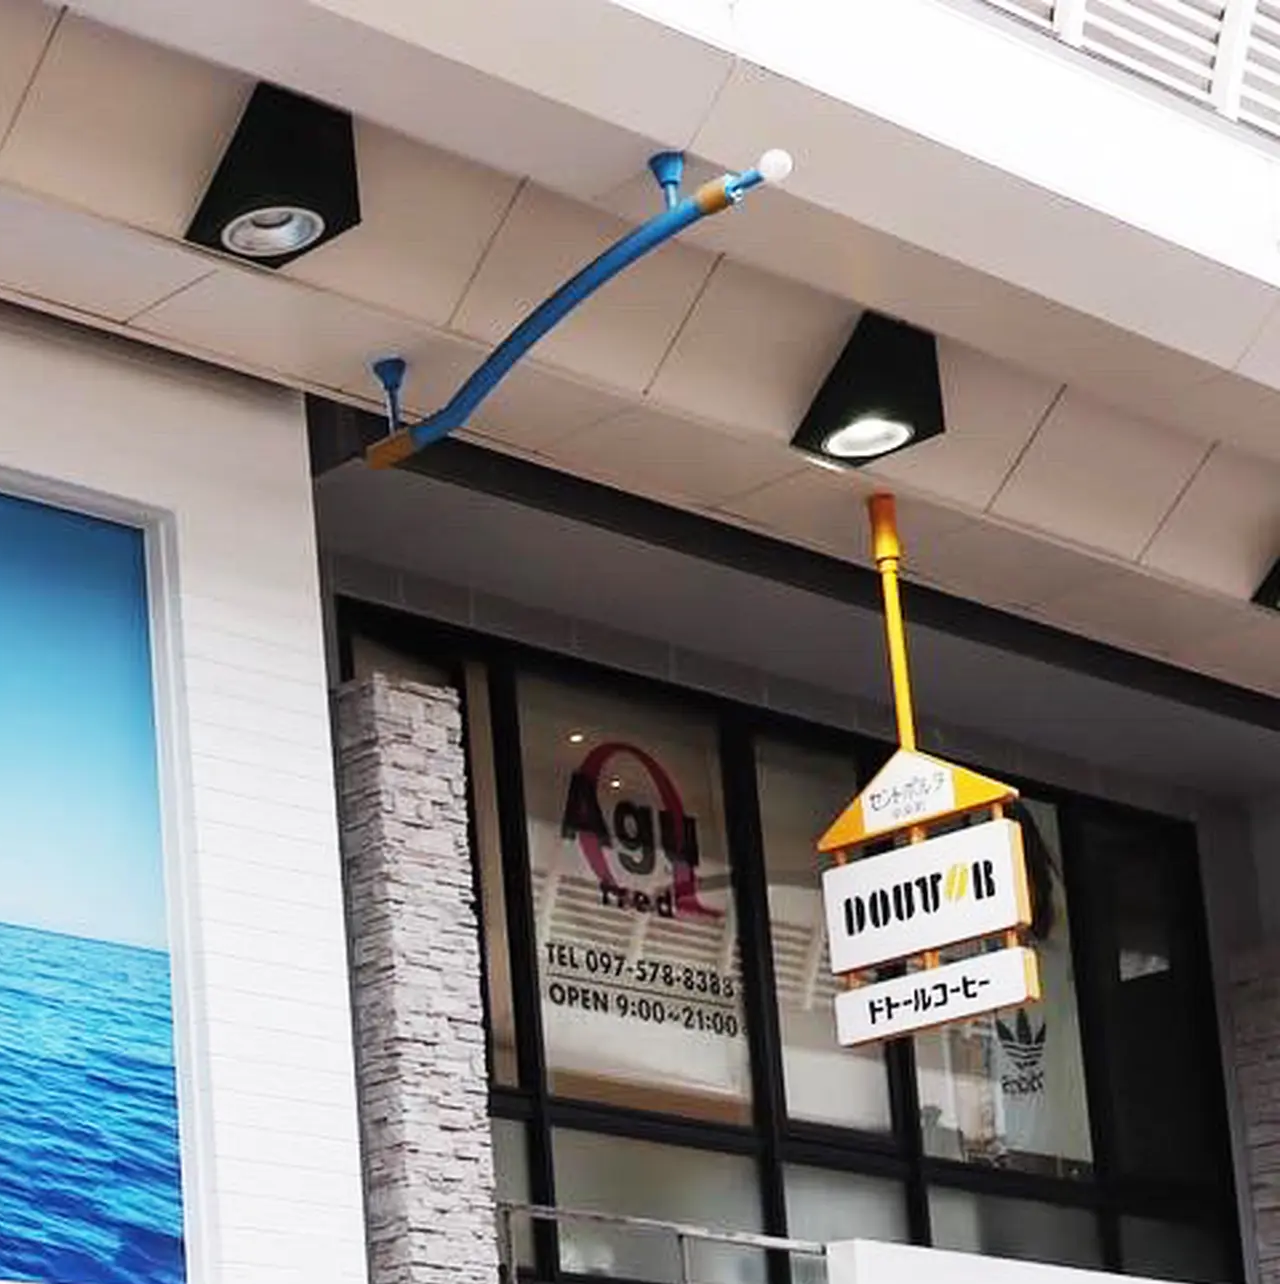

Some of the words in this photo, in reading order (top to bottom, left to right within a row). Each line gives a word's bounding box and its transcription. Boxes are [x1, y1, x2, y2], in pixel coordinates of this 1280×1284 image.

[561, 771, 700, 876] Agu
[843, 859, 997, 936] DOUTOR
[545, 943, 579, 969] TEL
[549, 982, 609, 1013] OPEN
[868, 975, 991, 1025] ドトールコーヒー
